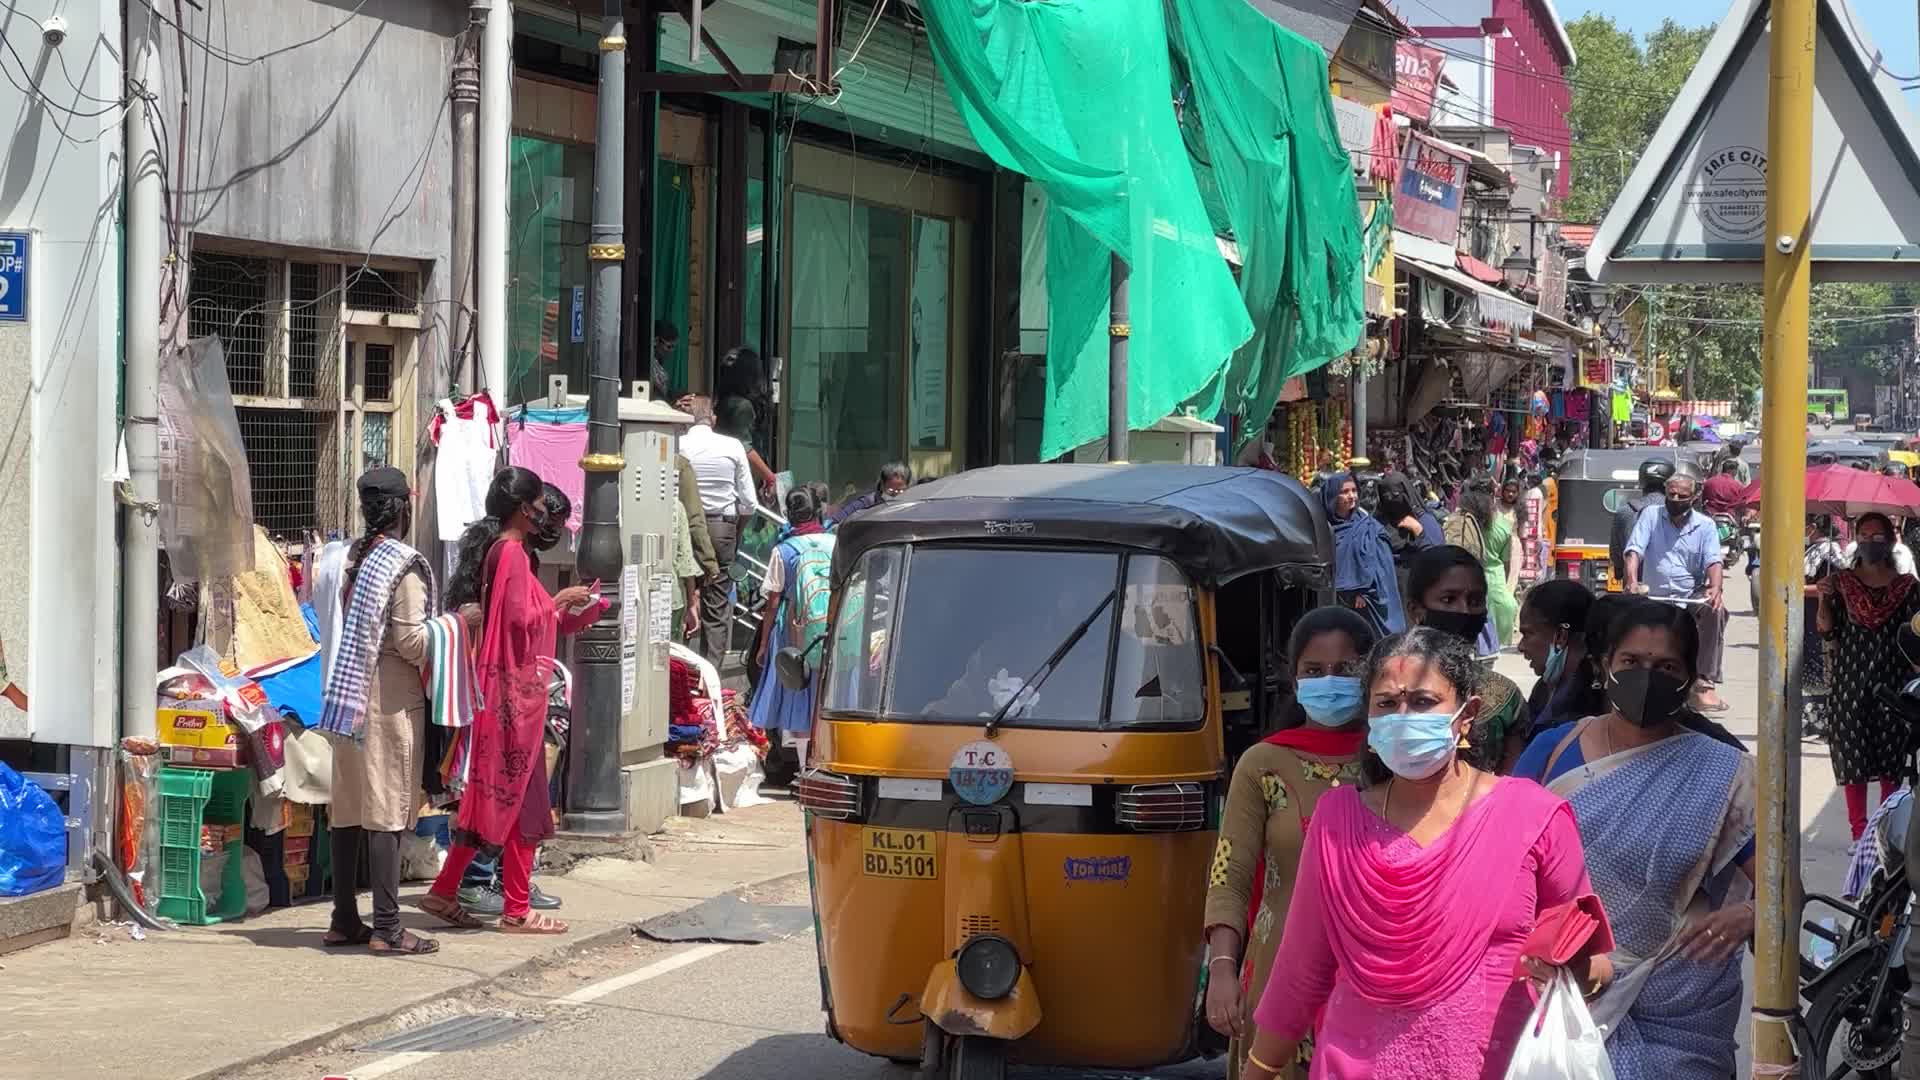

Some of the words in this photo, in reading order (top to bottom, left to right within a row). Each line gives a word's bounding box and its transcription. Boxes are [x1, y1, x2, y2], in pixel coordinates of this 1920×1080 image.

[1704, 152, 1735, 176] SAFE
[576, 313, 582, 336] 3
[872, 832, 925, 850] KL.01
[865, 854, 934, 877] BD.5101
